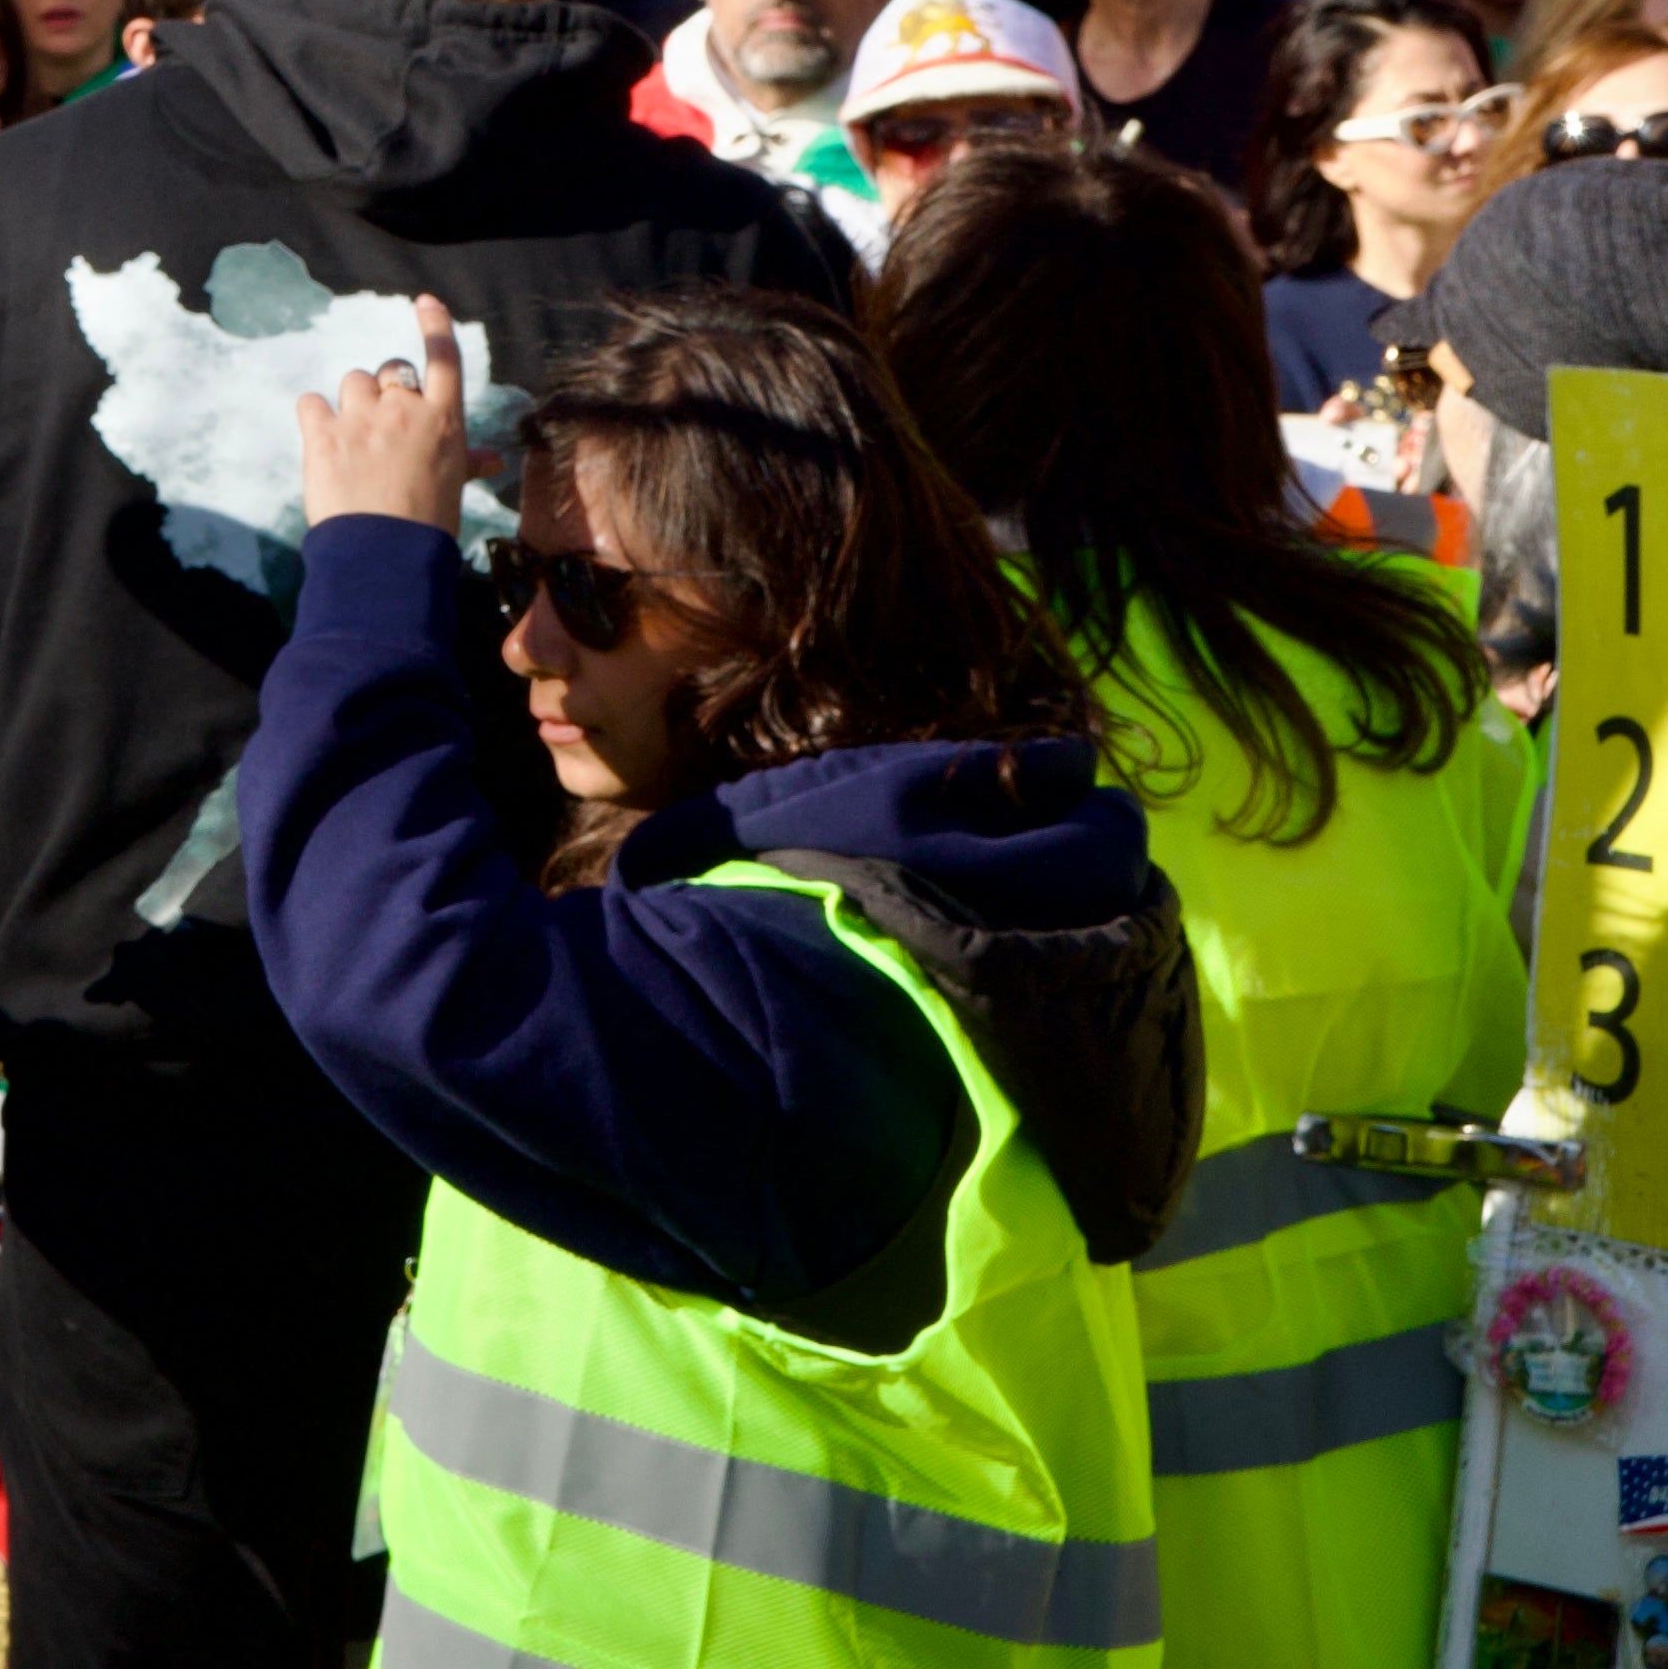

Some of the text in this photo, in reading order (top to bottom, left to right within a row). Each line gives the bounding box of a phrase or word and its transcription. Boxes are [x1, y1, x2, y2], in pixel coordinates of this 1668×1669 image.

[1604, 483, 1641, 637] 1
[1586, 716, 1654, 873] 2
[1571, 948, 1642, 1106] 3
